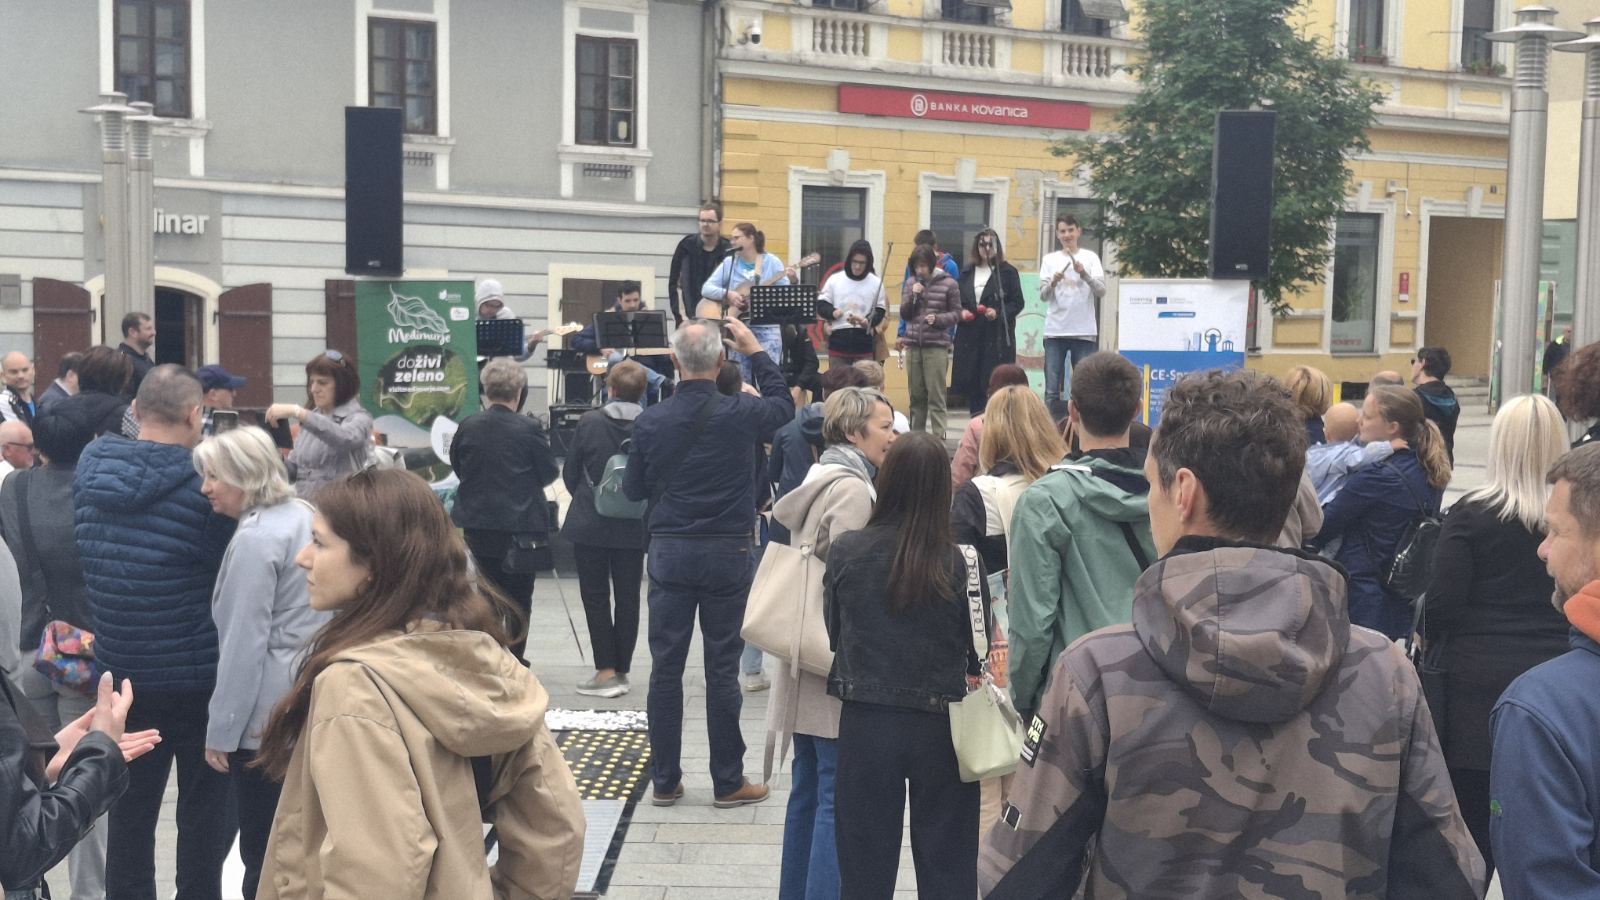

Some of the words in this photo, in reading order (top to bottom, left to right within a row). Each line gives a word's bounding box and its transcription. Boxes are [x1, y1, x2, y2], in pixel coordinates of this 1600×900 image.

[930, 101, 968, 113] BANKA
[397, 354, 441, 369] doživi
[394, 369, 445, 383] zeleno
